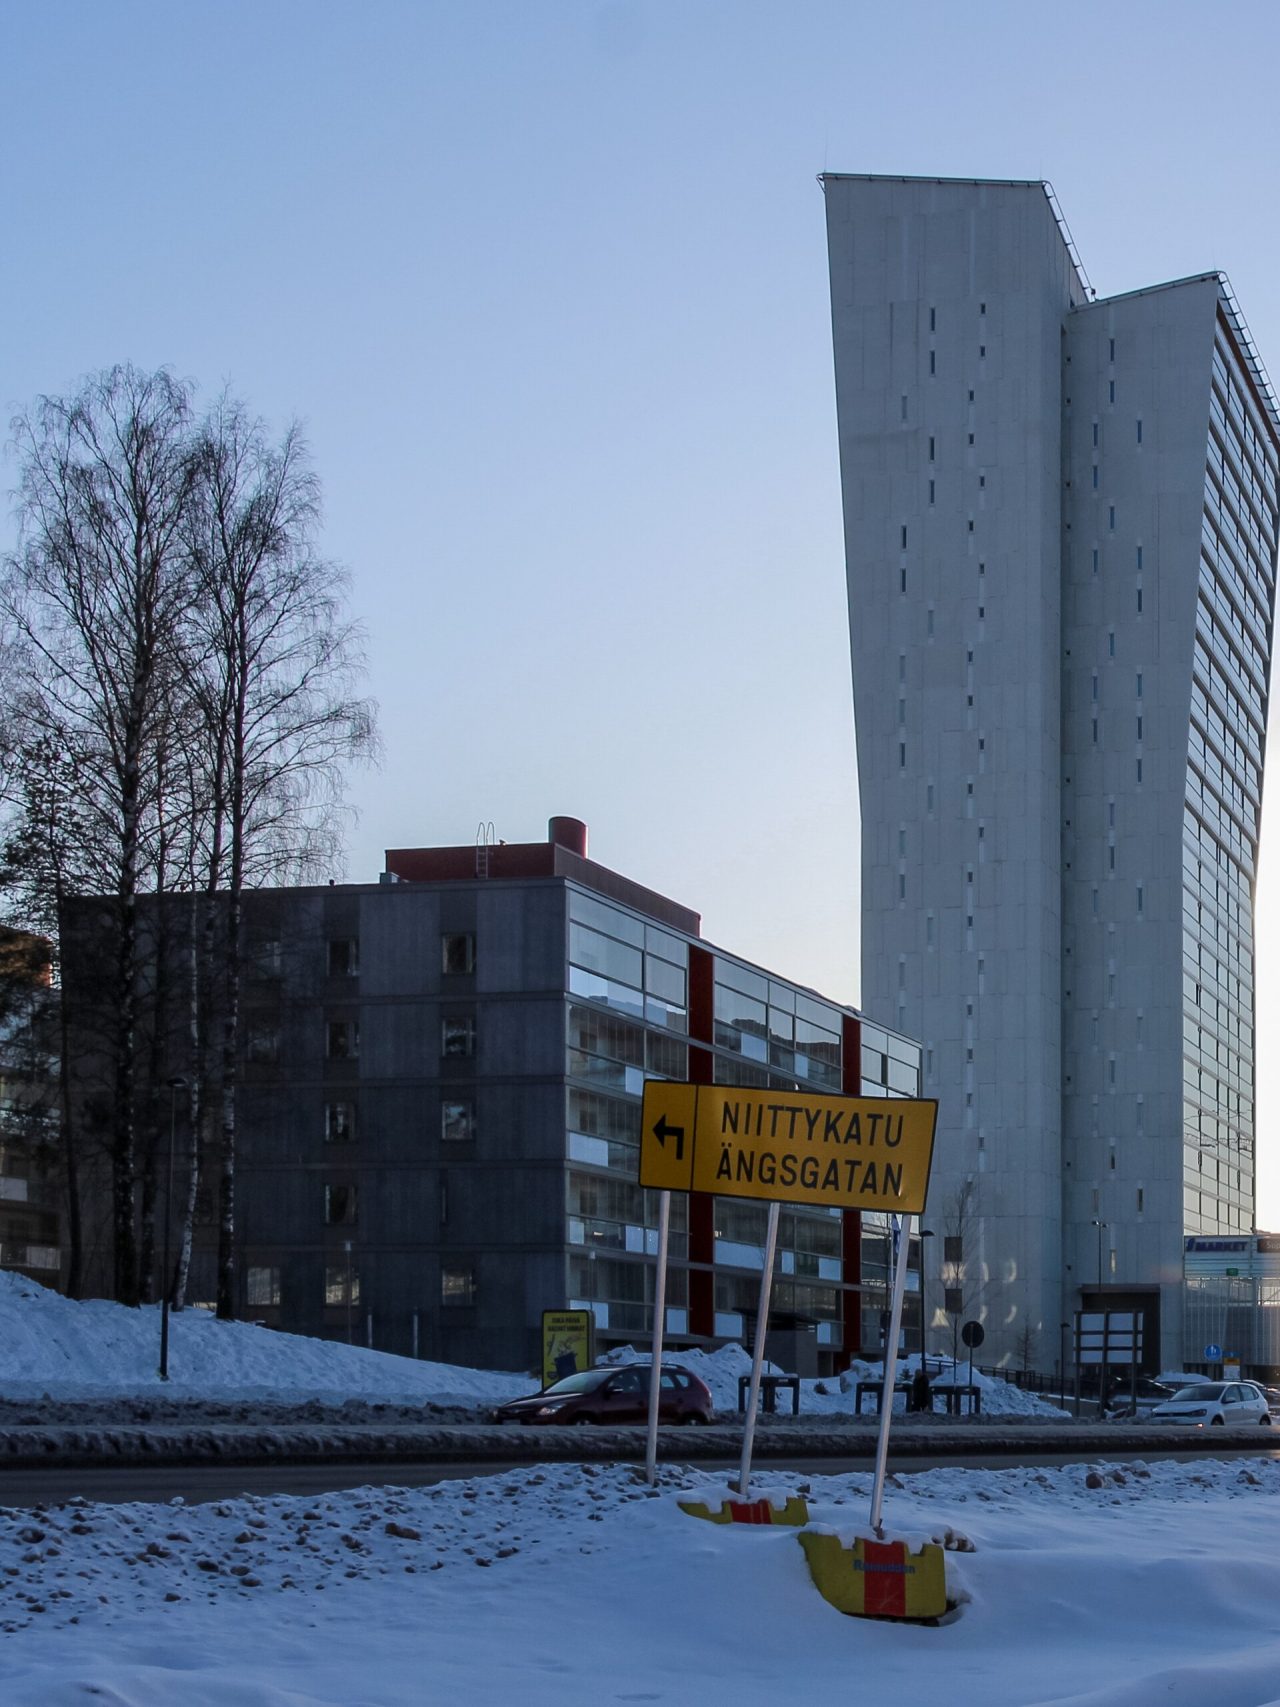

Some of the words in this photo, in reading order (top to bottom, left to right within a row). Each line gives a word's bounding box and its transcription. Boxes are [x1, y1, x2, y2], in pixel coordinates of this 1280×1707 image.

[721, 1101, 904, 1148] NIITTYKATU
[716, 1142, 903, 1197] ÄNGSGATAN
[1195, 1241, 1249, 1252] MARKET
